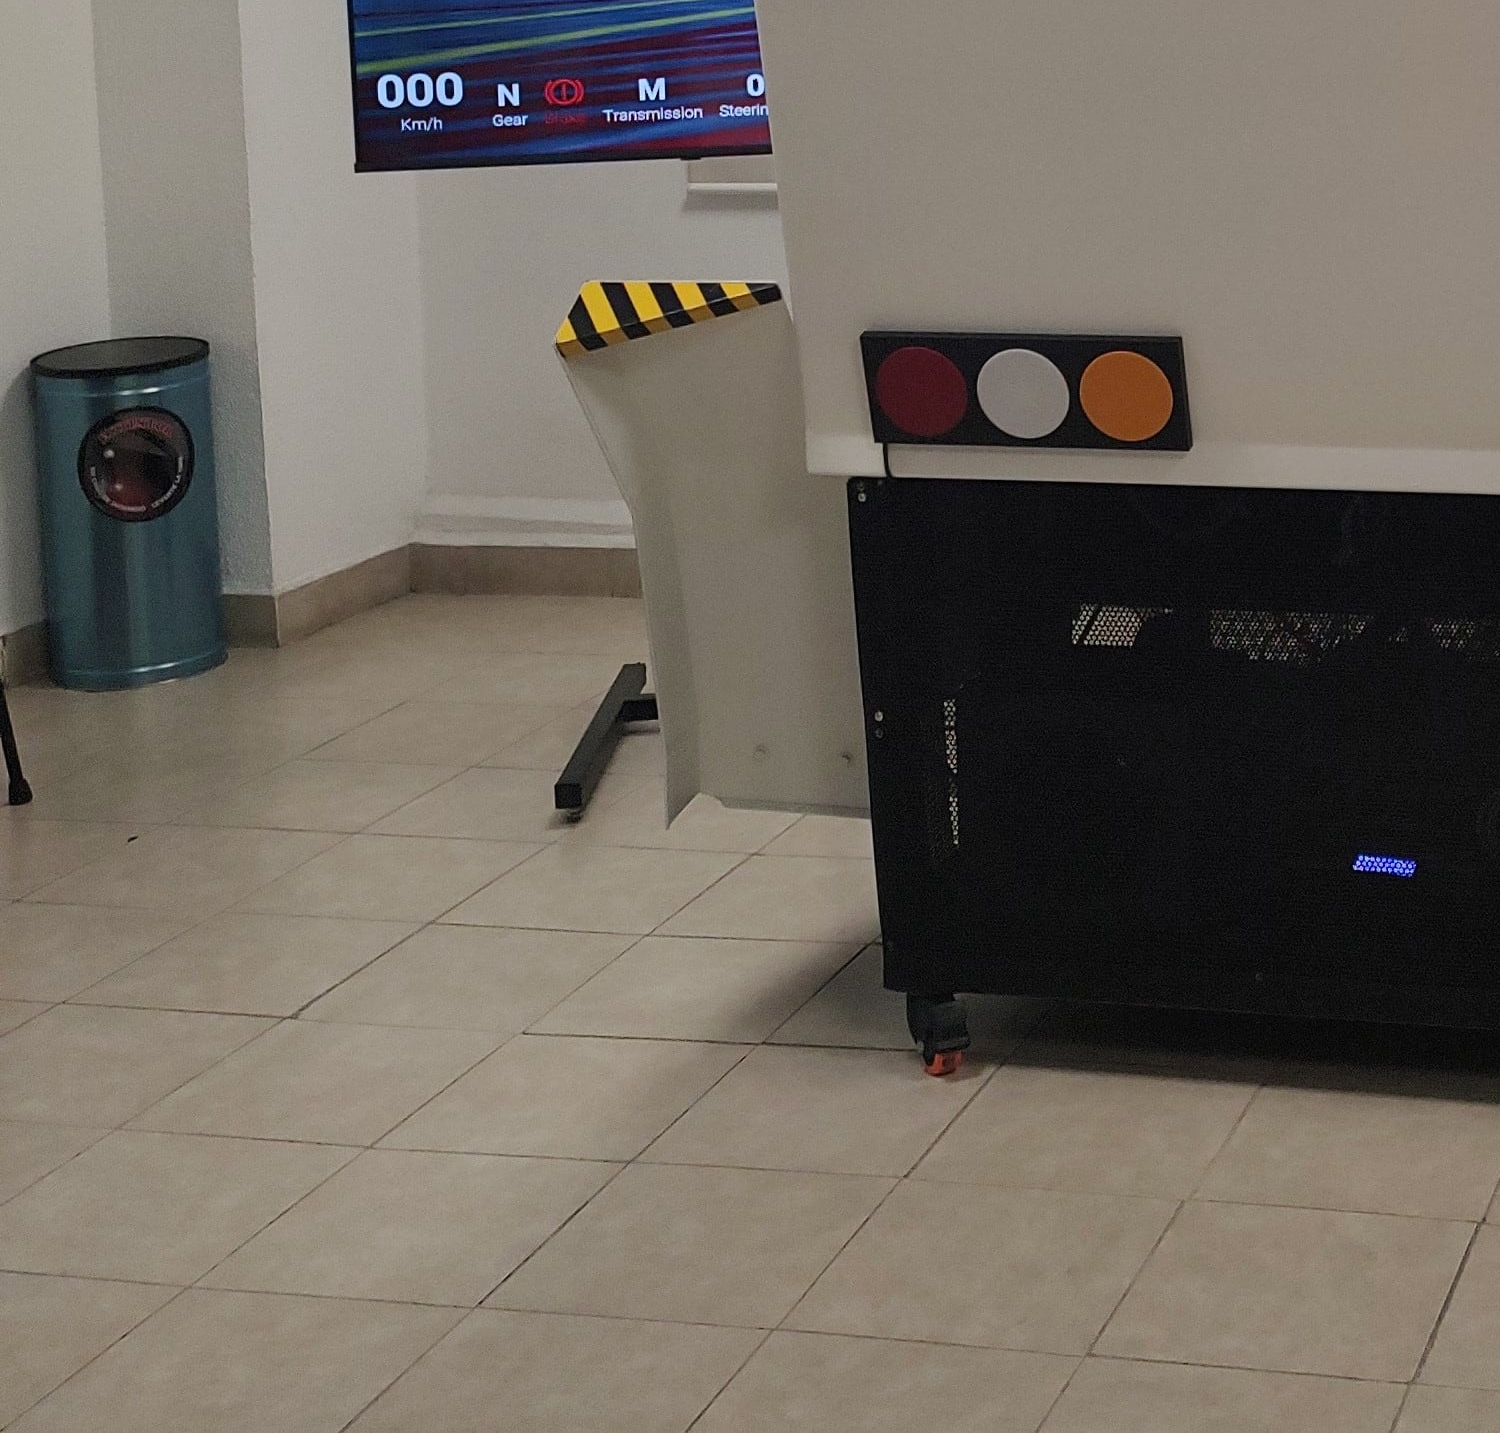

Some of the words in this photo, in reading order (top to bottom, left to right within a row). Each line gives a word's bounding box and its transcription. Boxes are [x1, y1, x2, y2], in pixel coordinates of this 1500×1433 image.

[376, 71, 464, 109] 000
[497, 83, 520, 107] N
[638, 77, 666, 101] M
[400, 116, 443, 132] Km/h
[492, 113, 528, 128] Gear
[602, 105, 703, 123] Transmission
